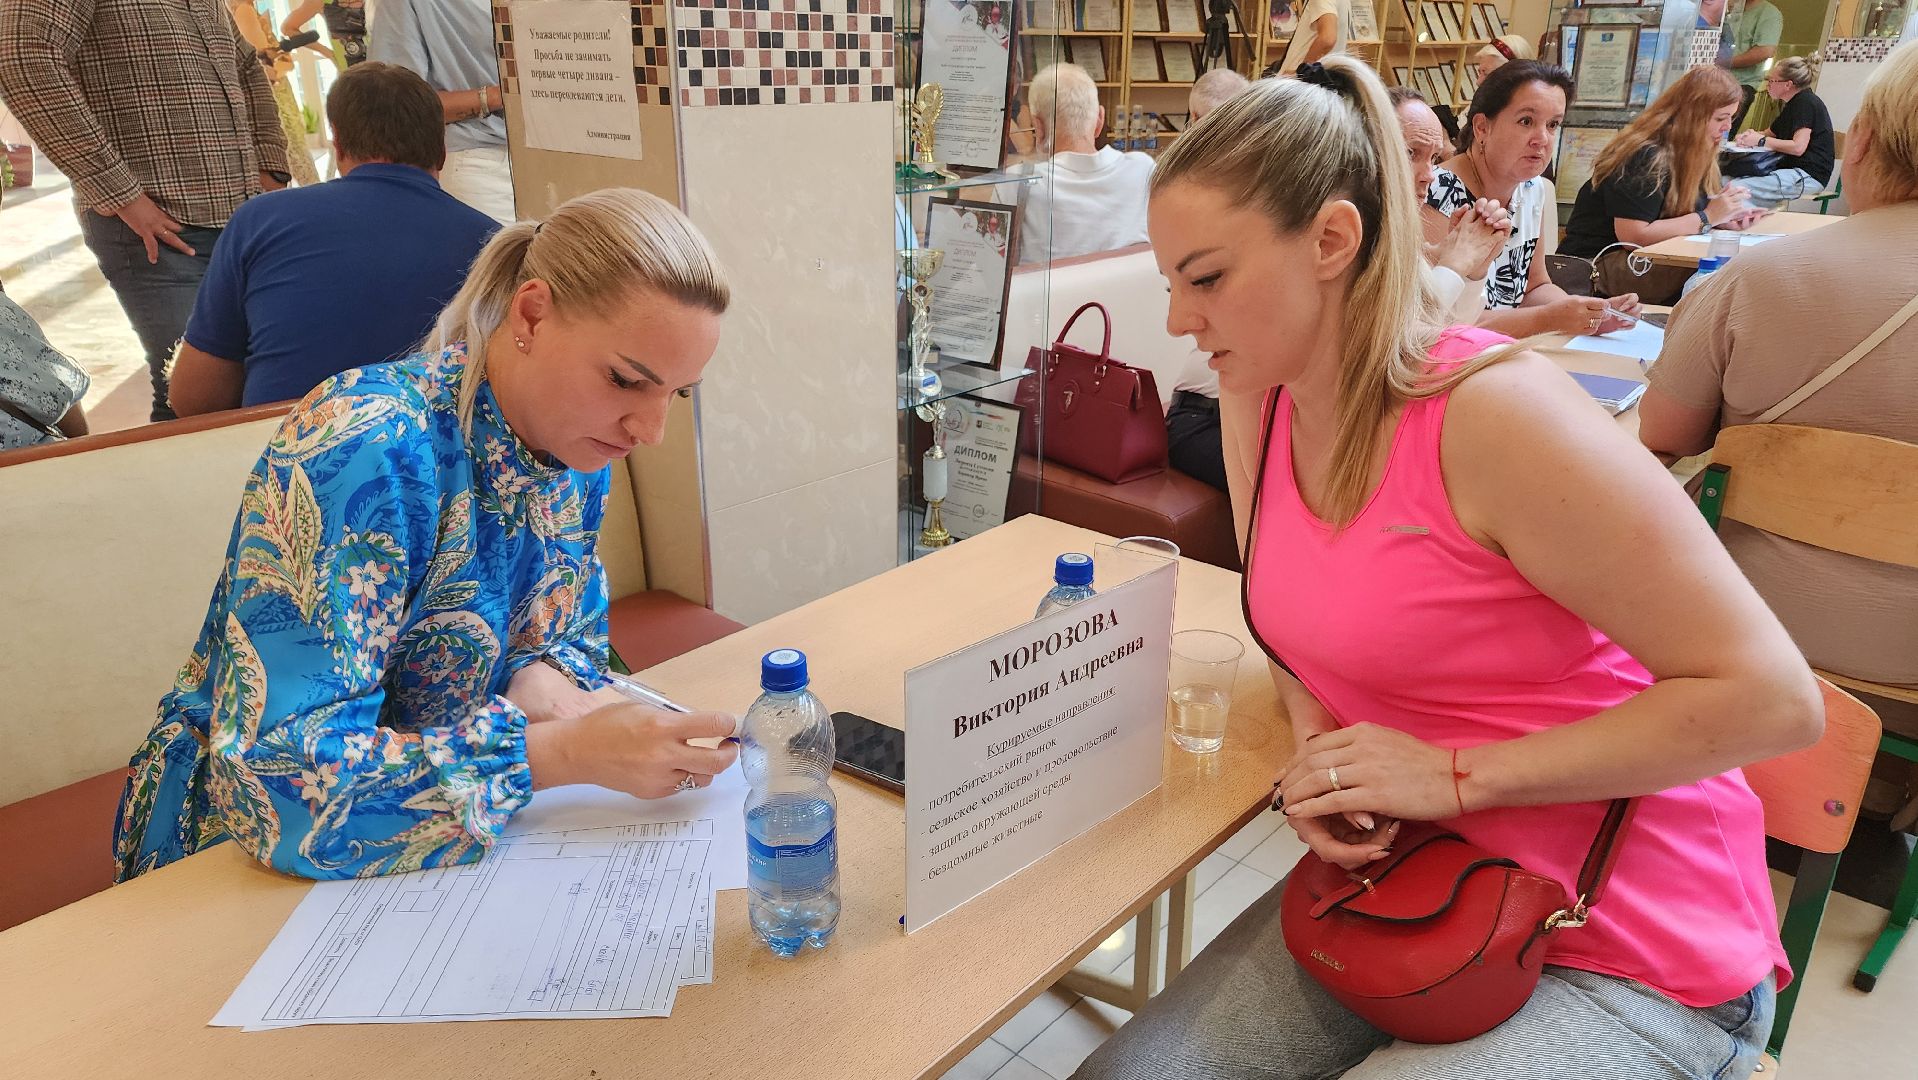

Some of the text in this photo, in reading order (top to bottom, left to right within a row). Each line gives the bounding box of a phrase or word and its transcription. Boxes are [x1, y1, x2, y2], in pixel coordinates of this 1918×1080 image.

[530, 28, 611, 43] Уважаемые родители!
[534, 49, 612, 62] Просьба не занимать
[531, 70, 556, 81] первые
[558, 71, 584, 82] четыре
[585, 72, 614, 81] дивана
[531, 90, 626, 103] здесь переодеваются дети.
[586, 130, 631, 141] Администрация
[954, 445, 997, 463] ДИПЛОМ
[988, 608, 1119, 684] МОРОЗОВА
[953, 636, 1144, 739] Виктория Андреевна
[986, 685, 1117, 759] Курируемые направления:
[929, 753, 1022, 811] потребительский
[1025, 738, 1057, 763] рынок
[929, 801, 978, 834] сельское
[980, 772, 1033, 807] хозяйство
[1044, 726, 1118, 773] продовольствие
[929, 829, 969, 857] защита
[971, 788, 1041, 830] окружающей
[1043, 773, 1072, 795] среды
[928, 840, 989, 880] бездомные
